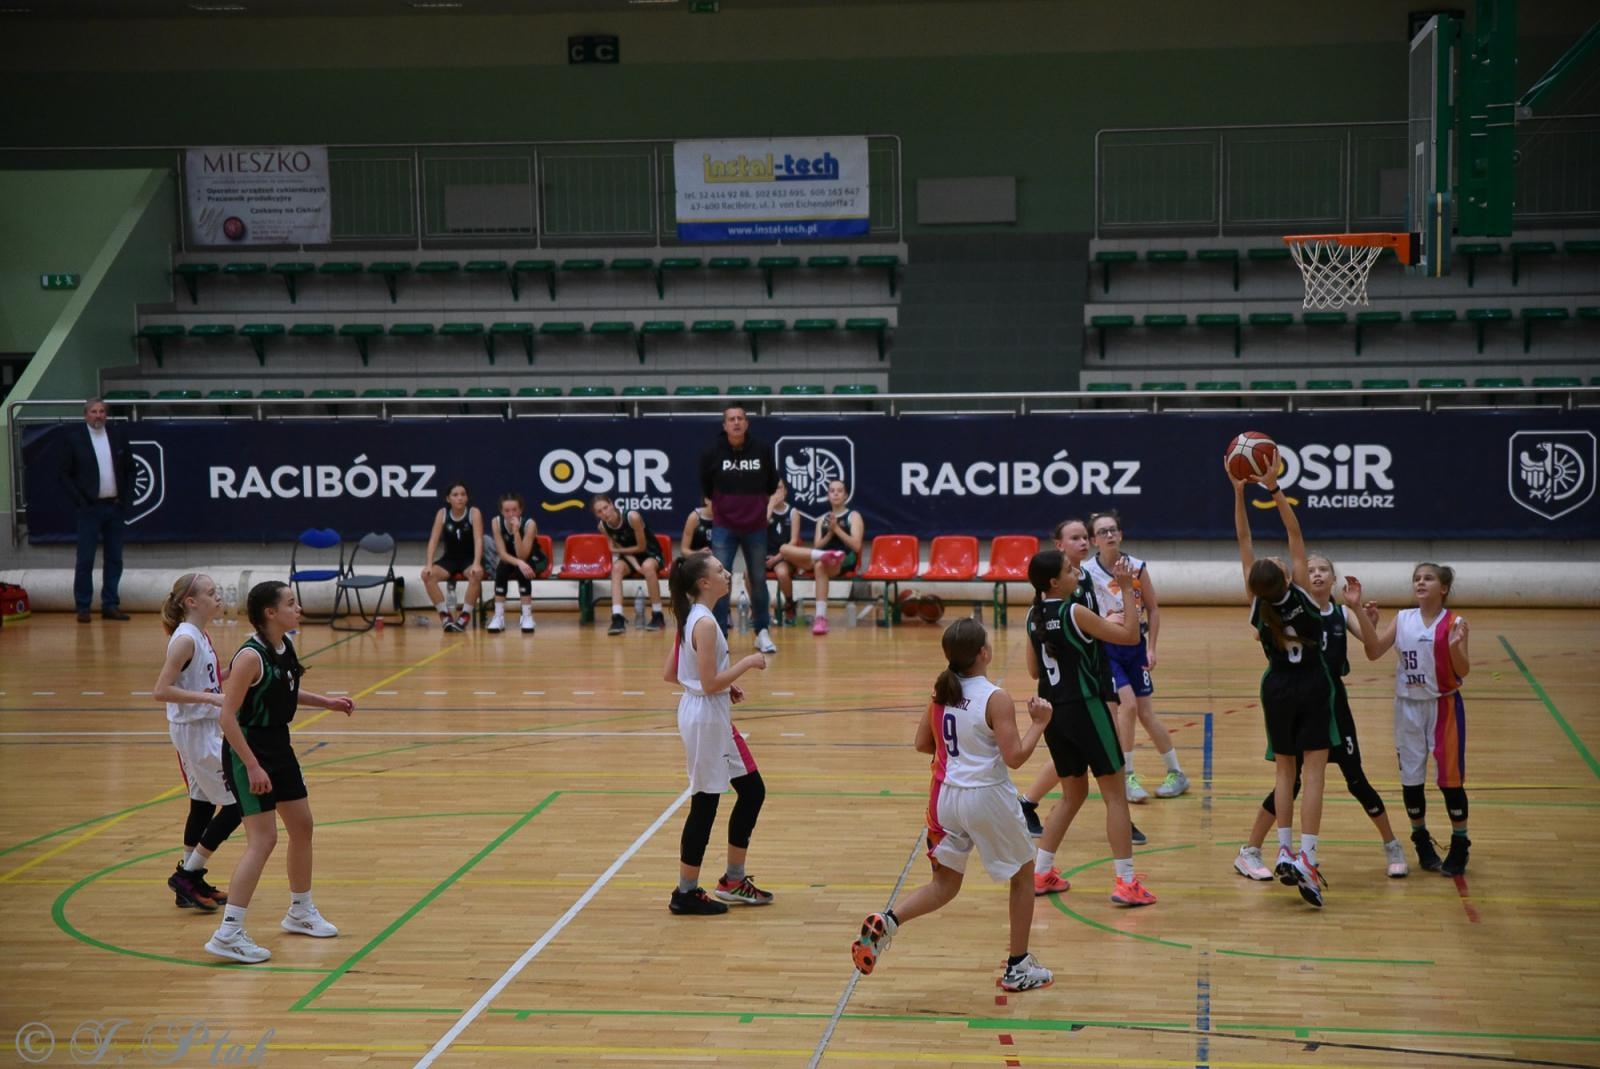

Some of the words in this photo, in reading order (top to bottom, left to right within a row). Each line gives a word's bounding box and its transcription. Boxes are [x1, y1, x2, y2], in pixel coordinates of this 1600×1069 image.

[203, 151, 311, 173] MIESZKO
[703, 152, 840, 183] instal-tech
[690, 202, 720, 211] 47-400
[728, 222, 818, 236] www.instal-tech.pl
[539, 448, 672, 494] OSiR
[722, 459, 761, 471] PARIS
[901, 449, 1142, 496] RACIBÓRZ
[209, 453, 438, 499] RACIBÓRZ
[614, 495, 673, 511] CIBÓRZ
[1307, 491, 1395, 509] RACIBÓRZ
[206, 663, 216, 683] 2
[1143, 670, 1151, 687] 8
[943, 713, 960, 757] 9
[1345, 736, 1354, 755] 3
